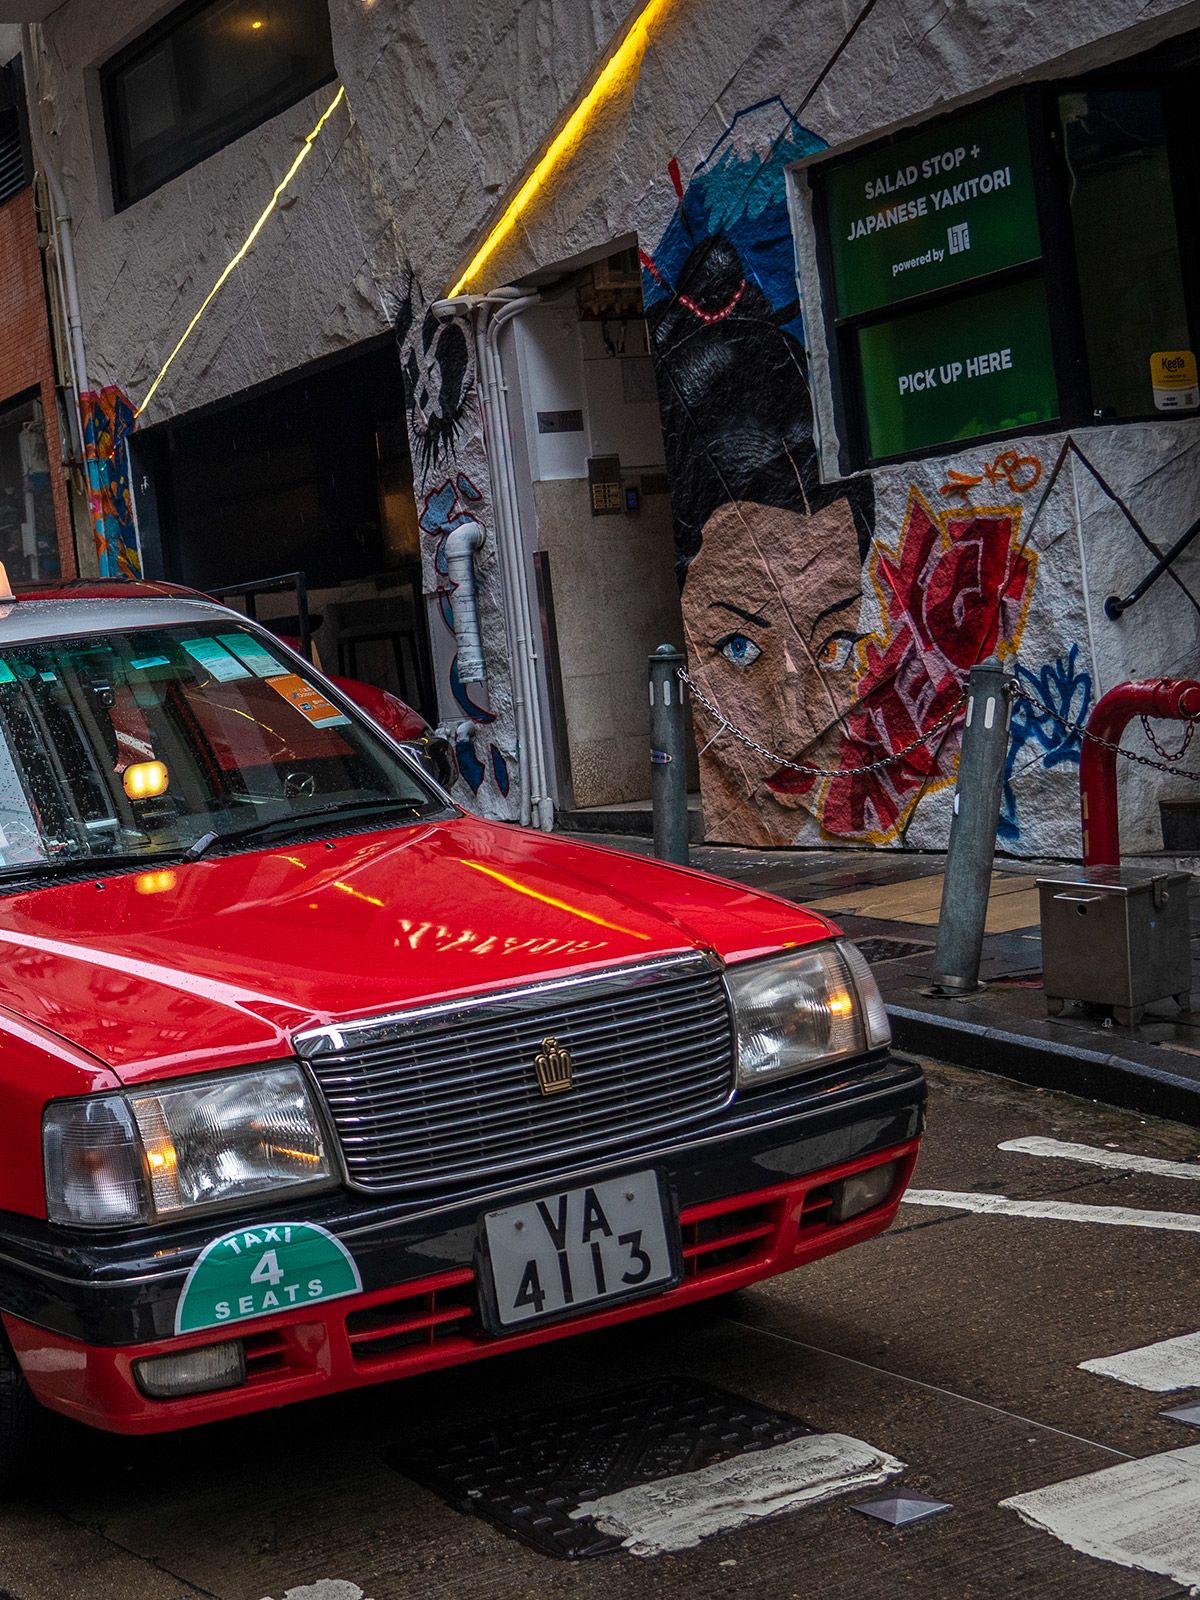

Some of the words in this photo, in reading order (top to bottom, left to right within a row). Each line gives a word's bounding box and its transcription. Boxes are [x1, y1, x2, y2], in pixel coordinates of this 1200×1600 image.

[864, 165, 918, 200] SALAD
[922, 146, 966, 180] STOP
[847, 196, 928, 241] JAPANESE
[930, 166, 1012, 212] YAKITORI
[892, 249, 931, 277] powered
[932, 248, 945, 262] by
[898, 367, 937, 396] PICK
[940, 361, 963, 385] UP
[966, 348, 1013, 379] HERE
[223, 1226, 292, 1255] TAXI
[535, 1187, 614, 1252] VA
[250, 1249, 285, 1286] 4
[513, 1229, 652, 1313] 4113
[215, 1278, 323, 1320] SEATS
